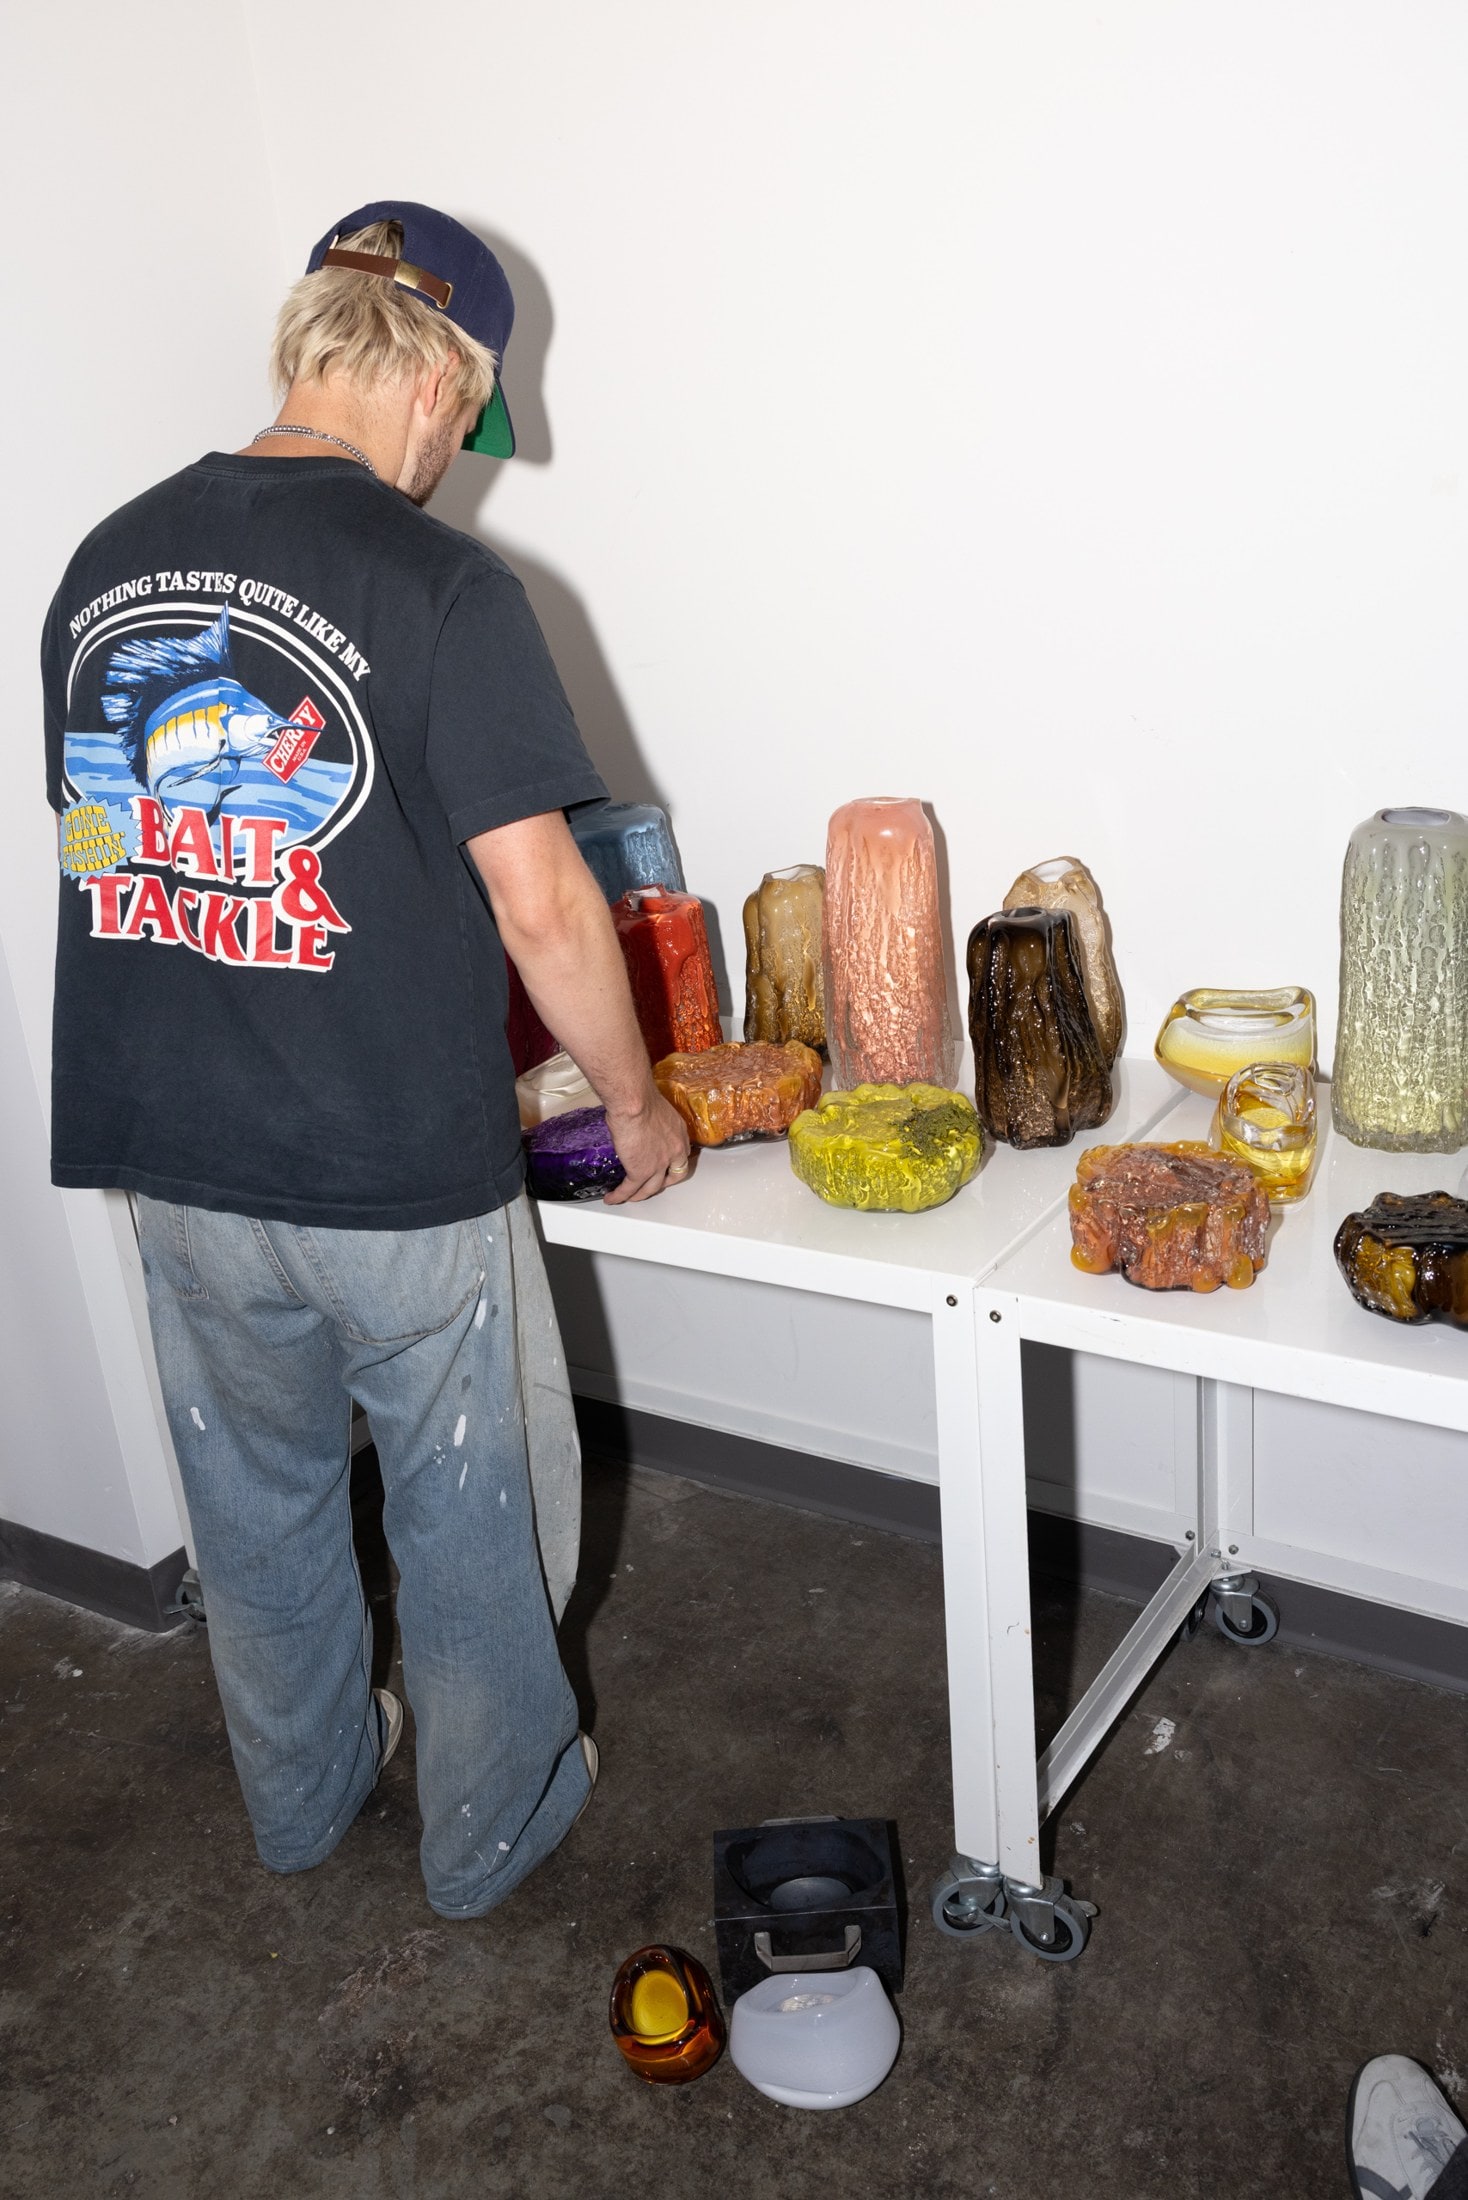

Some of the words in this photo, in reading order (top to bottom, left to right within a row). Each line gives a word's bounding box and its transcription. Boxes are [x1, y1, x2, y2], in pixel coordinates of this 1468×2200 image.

[69, 579, 152, 639] NOTHING
[155, 571, 238, 593] TASTES
[239, 579, 299, 617] QUITE
[294, 604, 346, 654] LIKE
[338, 638, 372, 682] MY
[65, 805, 112, 843] GONE
[128, 796, 287, 887] BAIT
[275, 846, 352, 933] &
[79, 875, 336, 972] TACKLE
